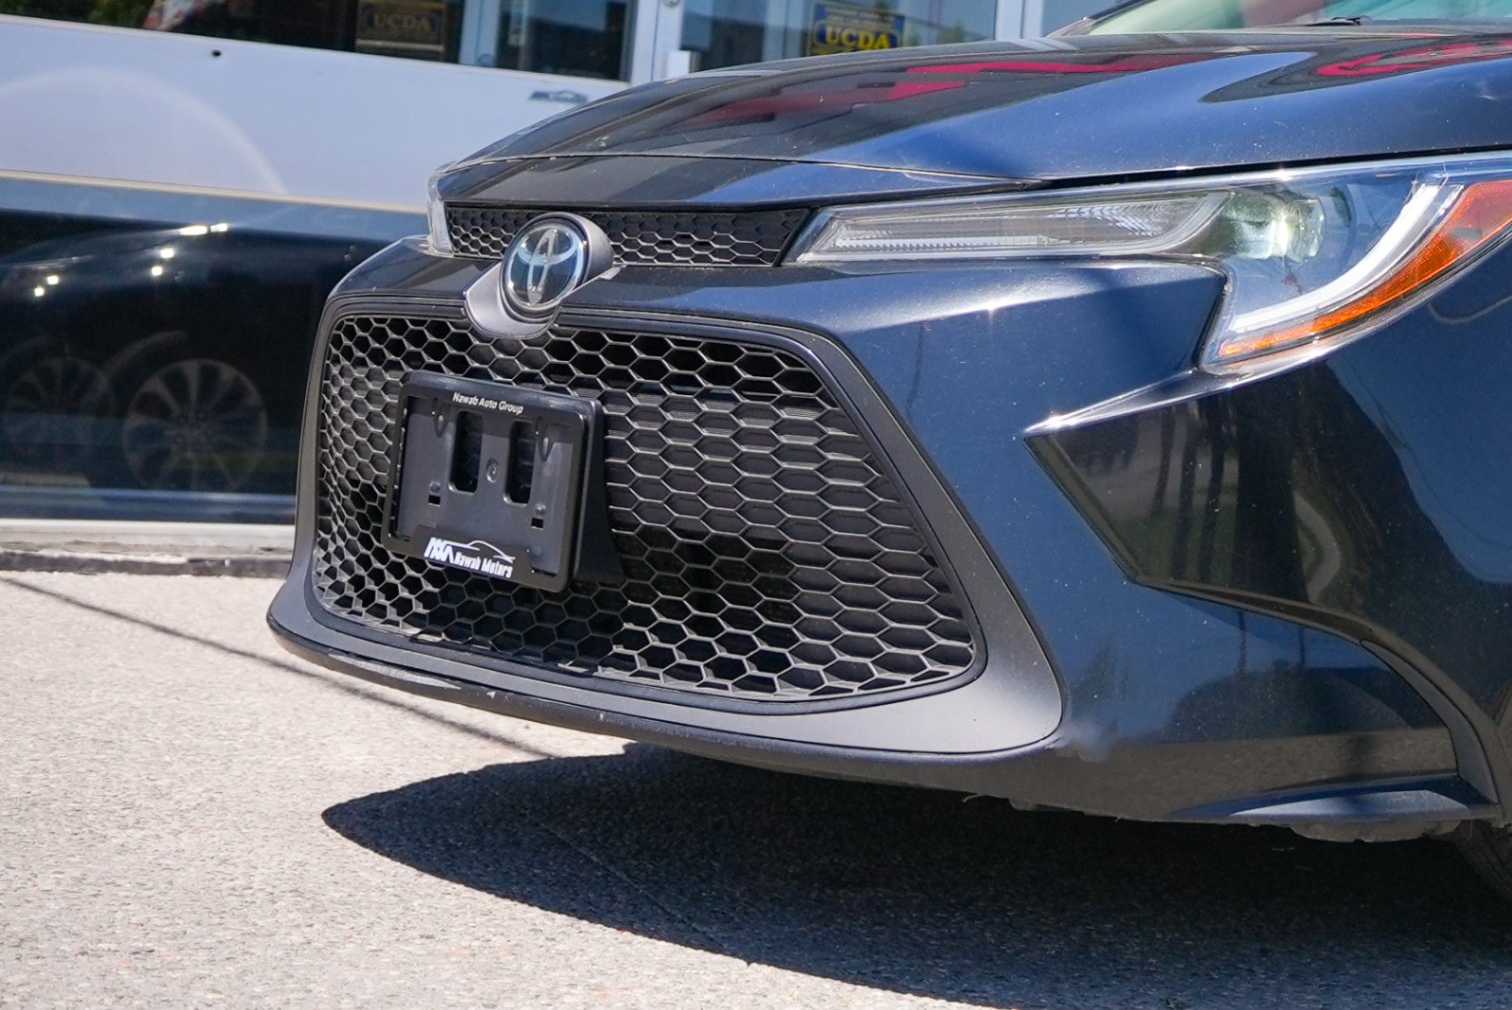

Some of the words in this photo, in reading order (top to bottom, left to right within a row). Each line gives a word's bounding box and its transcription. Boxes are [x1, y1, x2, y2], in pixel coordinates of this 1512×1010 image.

[826, 26, 890, 50] UCDA
[452, 392, 479, 406] Nawab
[478, 397, 498, 409] Auto
[498, 400, 524, 416] Group
[453, 551, 481, 571] Nawab
[481, 557, 513, 578] Motors
